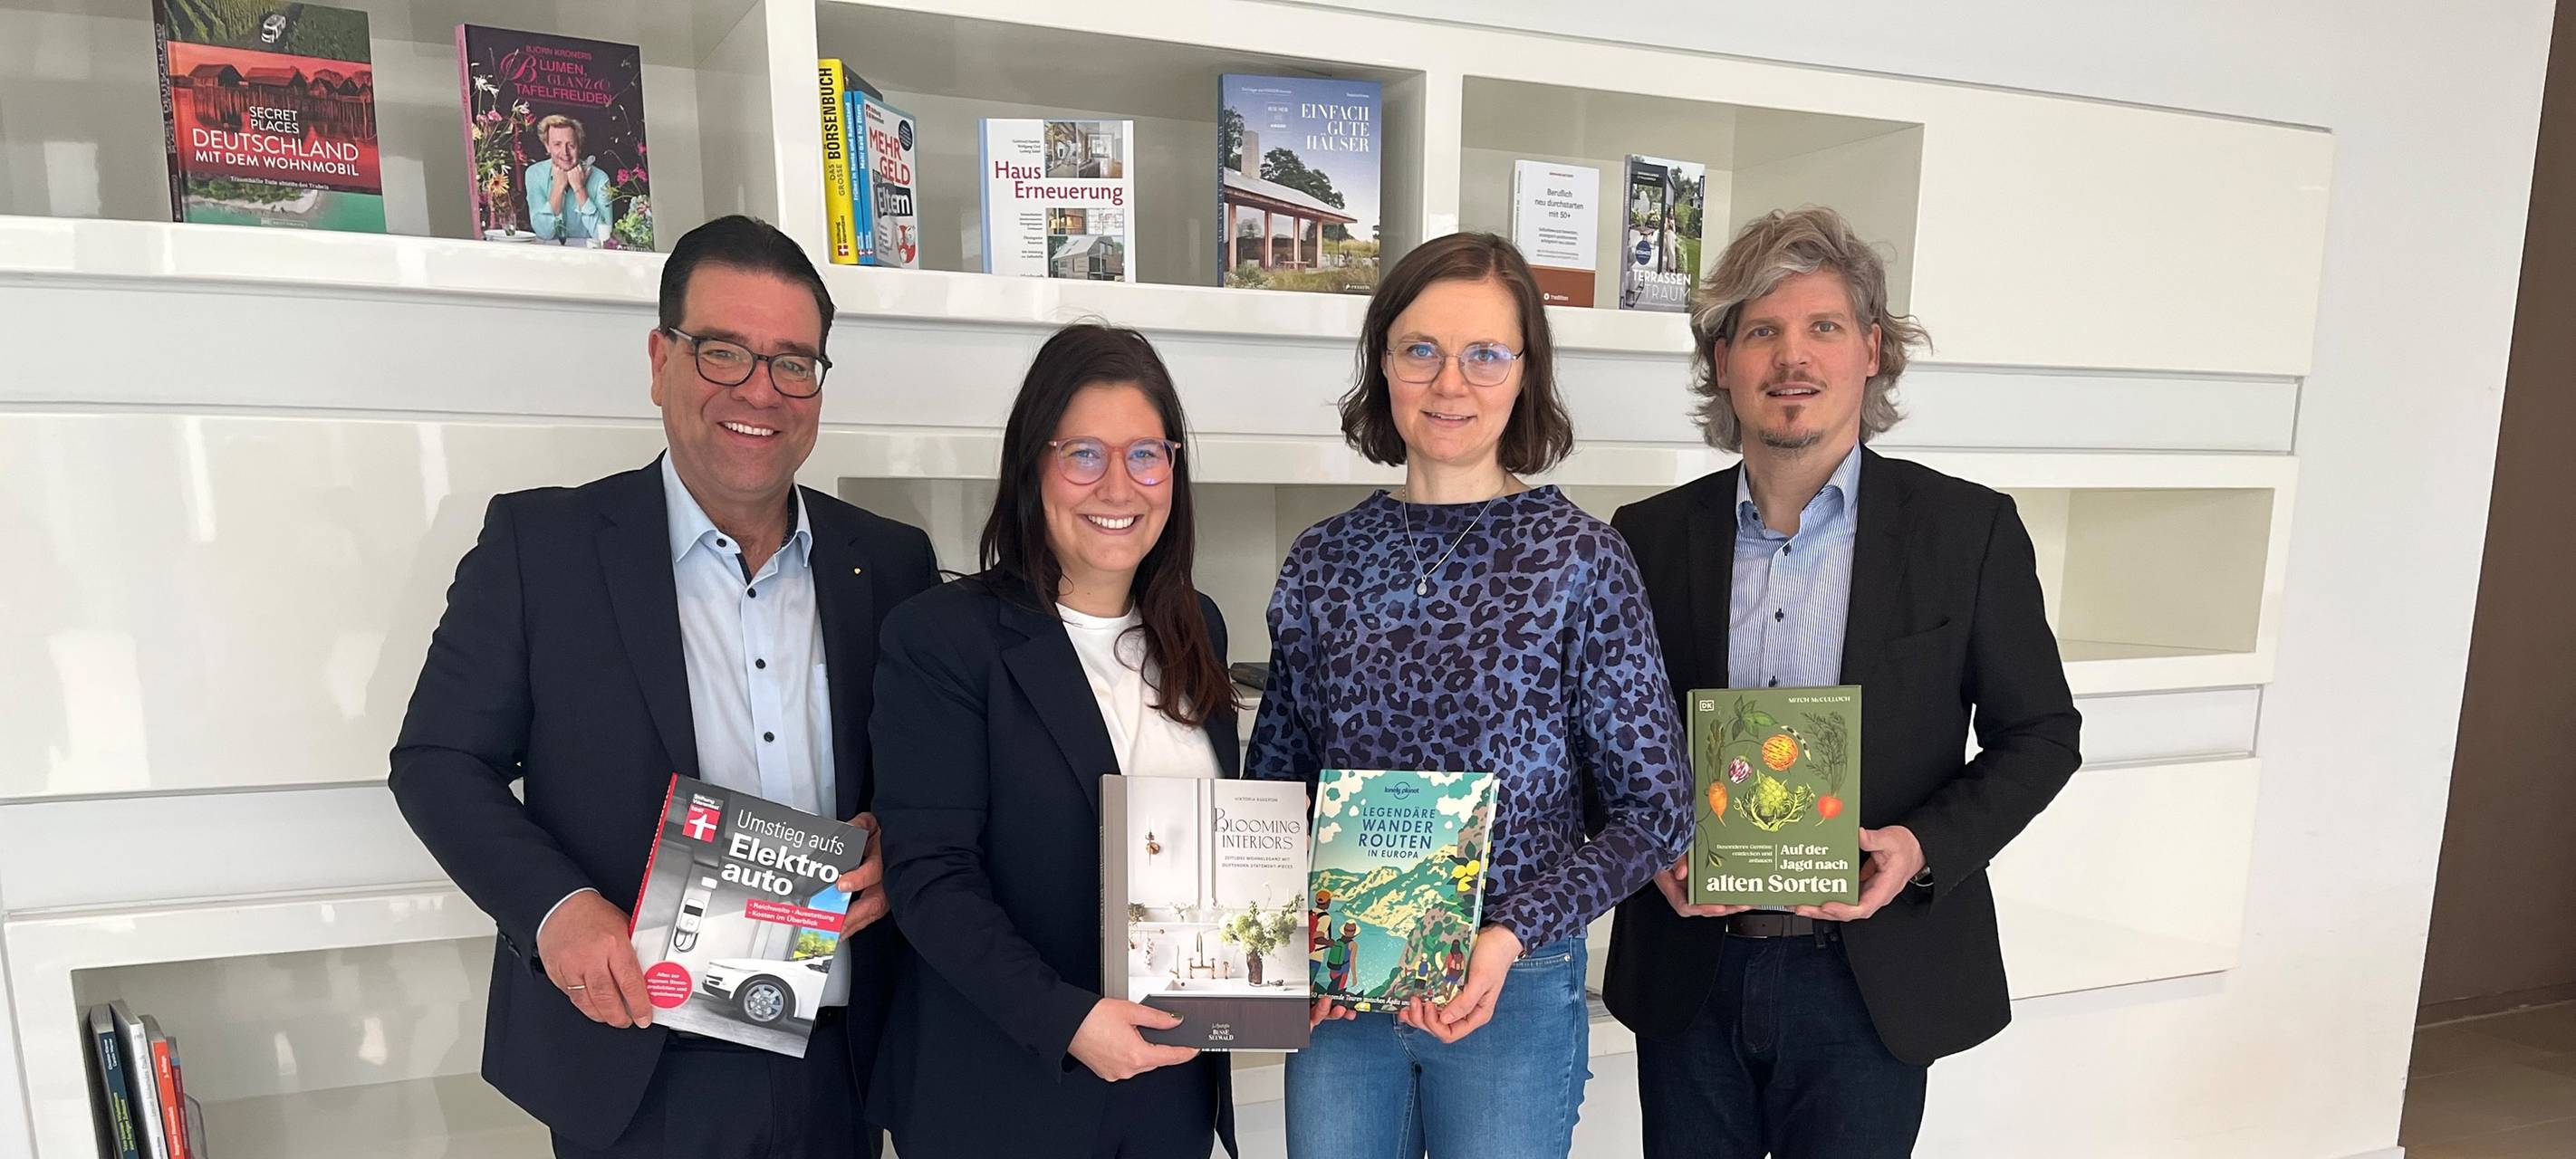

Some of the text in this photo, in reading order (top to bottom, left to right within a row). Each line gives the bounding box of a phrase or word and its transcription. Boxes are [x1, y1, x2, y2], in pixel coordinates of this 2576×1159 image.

[547, 74, 592, 90] GLANZ
[514, 83, 613, 106] TAFELFREUDEN
[249, 106, 298, 121] SECRET
[819, 68, 841, 159] BÖRSENBUCH
[1302, 103, 1370, 121] EINFACH
[251, 119, 299, 134] PLACES
[1327, 120, 1370, 137] GUTE
[192, 128, 360, 161] DEUTSCHLAND
[870, 127, 902, 160] MEHR
[1306, 132, 1370, 152] HÄUSER
[196, 150, 360, 176] MIT DEM WOHNMOBIL
[879, 156, 910, 186] GELD
[995, 160, 1042, 179] Haus
[836, 164, 845, 196] GROSSE
[877, 187, 910, 215] Eltern
[1014, 181, 1124, 206] Erneuerung
[1632, 269, 1691, 285] TERRASSEN
[1644, 283, 1691, 302] TRAUM
[1384, 786, 1419, 795] lonely planet
[1215, 808, 1301, 834] BLOOMING
[1363, 806, 1436, 819] LEGENDÄRE
[737, 809, 845, 855] Umstieg aufs
[1362, 819, 1433, 833] WANDER
[1222, 834, 1293, 849] INTERIORS
[1359, 833, 1432, 849] ROUTEN
[1780, 844, 1829, 856] Auf der
[1381, 850, 1418, 858] EUROPA
[1780, 859, 1848, 872] Jagd nach
[721, 862, 793, 896] auto
[1706, 874, 1848, 893] alten Sorten
[752, 910, 775, 920] Kosten
[786, 915, 818, 926] Überblick
[753, 903, 834, 922] Reichweite Ausstattung
